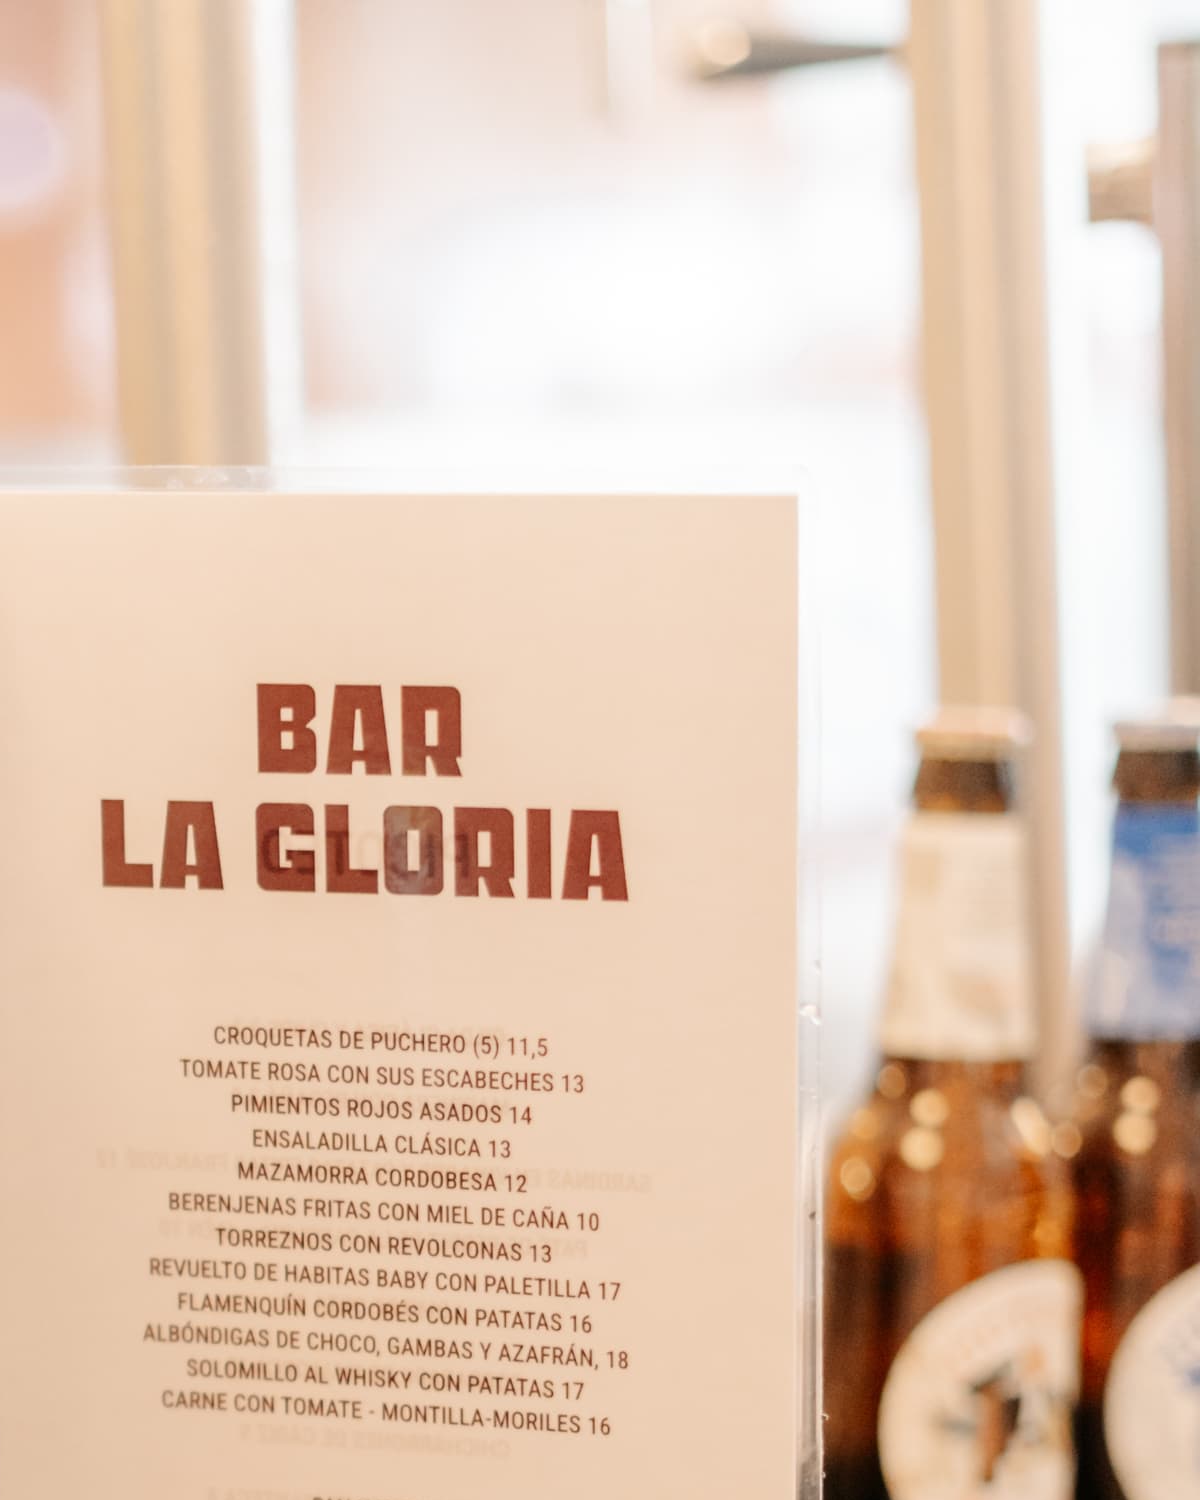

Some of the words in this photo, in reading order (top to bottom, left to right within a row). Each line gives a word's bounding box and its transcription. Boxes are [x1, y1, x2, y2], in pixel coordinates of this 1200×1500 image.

[256, 682, 462, 777] BAR
[100, 799, 224, 890] LA
[255, 802, 628, 902] GLORIA
[214, 1025, 332, 1048] CROQUETAS
[339, 1029, 364, 1050] DE
[370, 1031, 466, 1054] PUCHERO
[473, 1034, 499, 1059] (5)
[507, 1037, 548, 1059] 11,5
[180, 1058, 261, 1080] TOMATE
[268, 1062, 320, 1082] ROSA
[327, 1064, 369, 1084] CON
[376, 1066, 414, 1086] SUS
[422, 1068, 554, 1092] ESCABECHES
[562, 1074, 584, 1093] 13
[231, 1093, 340, 1116] PIMIENTOS
[346, 1098, 412, 1120] ROJOS
[419, 1101, 501, 1124] ASADOS
[510, 1106, 532, 1124] 14
[252, 1128, 388, 1152] ENSALADILLA
[394, 1132, 480, 1157] CLÁSICA
[488, 1139, 511, 1159] 13
[237, 1161, 368, 1185] MAZAMORRA
[375, 1167, 497, 1191] CORDOBESA
[504, 1174, 527, 1193] 12
[168, 1192, 296, 1216] BERENJENAS
[303, 1198, 371, 1220] FRITAS
[377, 1202, 419, 1222] CON
[427, 1204, 474, 1225] MIEL
[481, 1206, 505, 1226] DE
[512, 1206, 569, 1230] CAÑA
[577, 1212, 599, 1232] 10
[215, 1227, 332, 1251] TORREZNOS
[339, 1233, 381, 1254] CON
[388, 1236, 522, 1262] REVOLCONAS
[529, 1244, 552, 1263] 13
[149, 1257, 246, 1280] REVUELTO
[254, 1262, 277, 1282] DE
[284, 1264, 370, 1287] HABITAS
[376, 1268, 428, 1289] BABY
[435, 1271, 477, 1292] CON
[484, 1274, 590, 1299] PALETILLA
[599, 1281, 621, 1301] 17
[178, 1292, 306, 1317] FLAMENQUÍN
[313, 1299, 419, 1323] CORDOBÉS
[426, 1305, 467, 1326] CON
[475, 1308, 562, 1332] PATATAS
[570, 1314, 592, 1334] 16
[143, 1322, 269, 1347] ALBÓNDIGAS
[276, 1330, 299, 1349] DE
[307, 1331, 380, 1357] CHOCO,
[387, 1336, 473, 1359] GAMBAS
[479, 1342, 491, 1360] Y
[498, 1343, 598, 1371] AZAFRÁN,
[607, 1350, 628, 1370] 18
[187, 1358, 298, 1382] SOLOMILLO
[304, 1365, 328, 1384] AL
[335, 1367, 412, 1389] WHISKY
[419, 1371, 460, 1392] CON
[467, 1374, 554, 1398] PATATAS
[562, 1381, 584, 1400] 17
[162, 1390, 227, 1410] CARNE
[233, 1393, 275, 1413] CON
[281, 1396, 362, 1419] TOMATE
[382, 1402, 581, 1434] MONTILLA-MORILES
[588, 1416, 611, 1436] 16
